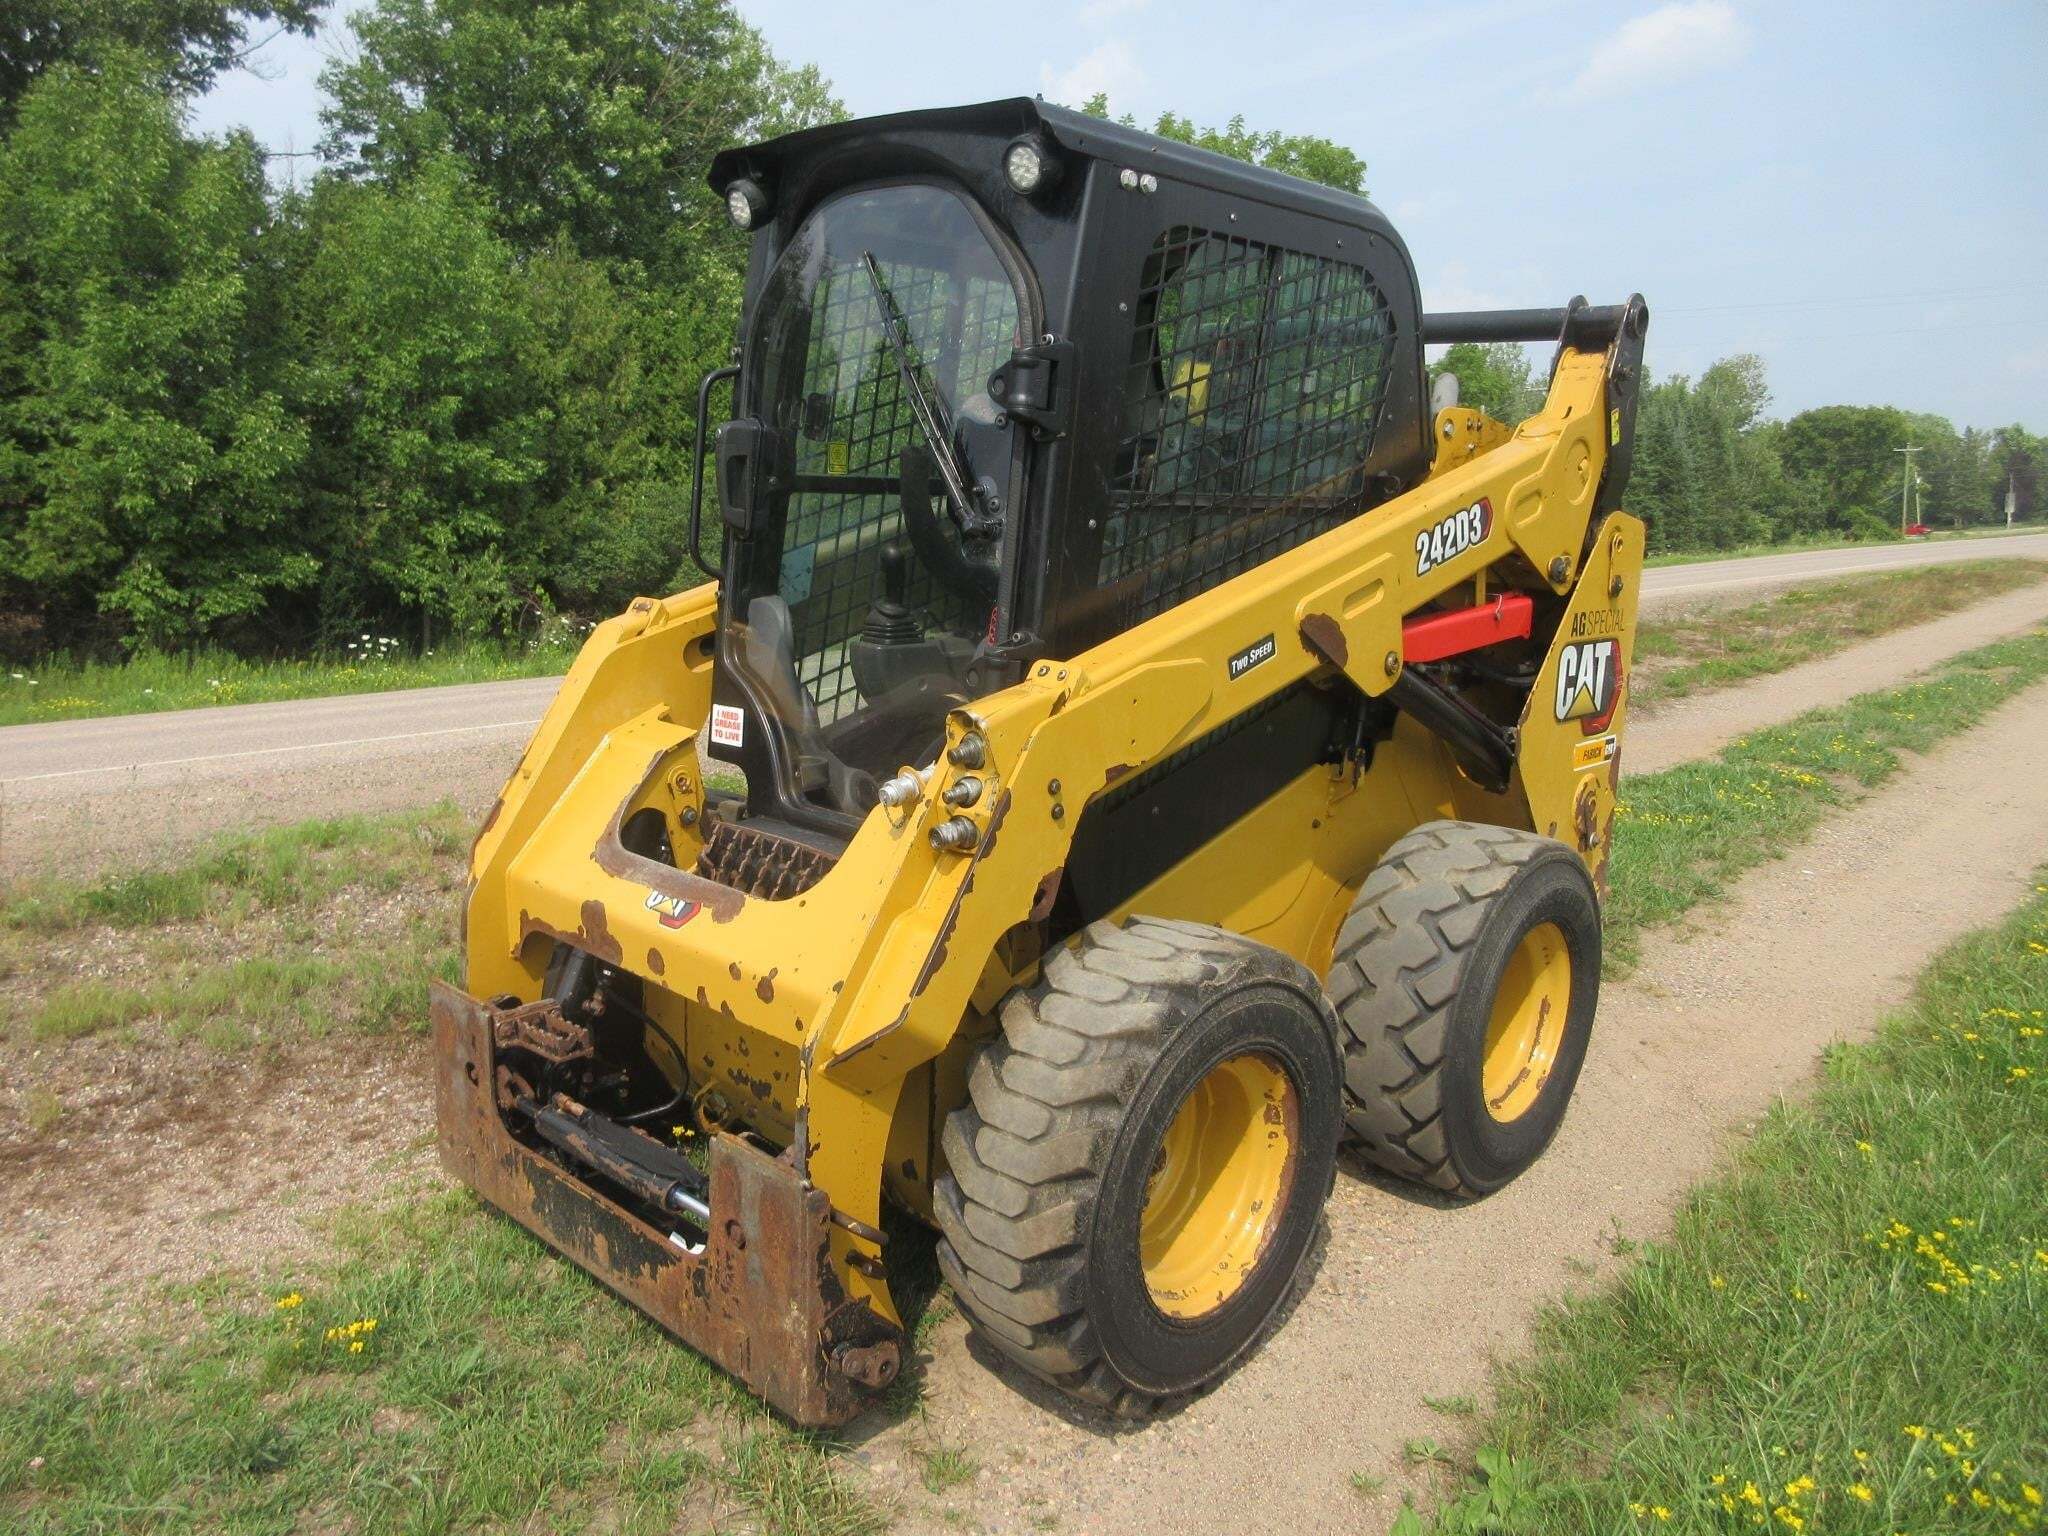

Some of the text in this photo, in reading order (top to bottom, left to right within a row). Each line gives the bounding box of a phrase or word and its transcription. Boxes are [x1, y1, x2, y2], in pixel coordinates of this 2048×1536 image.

[1416, 503, 1482, 575] 242D3
[1571, 608, 1624, 637] AG SPECIAL
[1231, 641, 1273, 674] TWO SPEED
[1556, 641, 1612, 720] CAT
[714, 718, 742, 731] GREASE
[721, 710, 738, 721] NEED
[714, 729, 740, 742] TO LIVE
